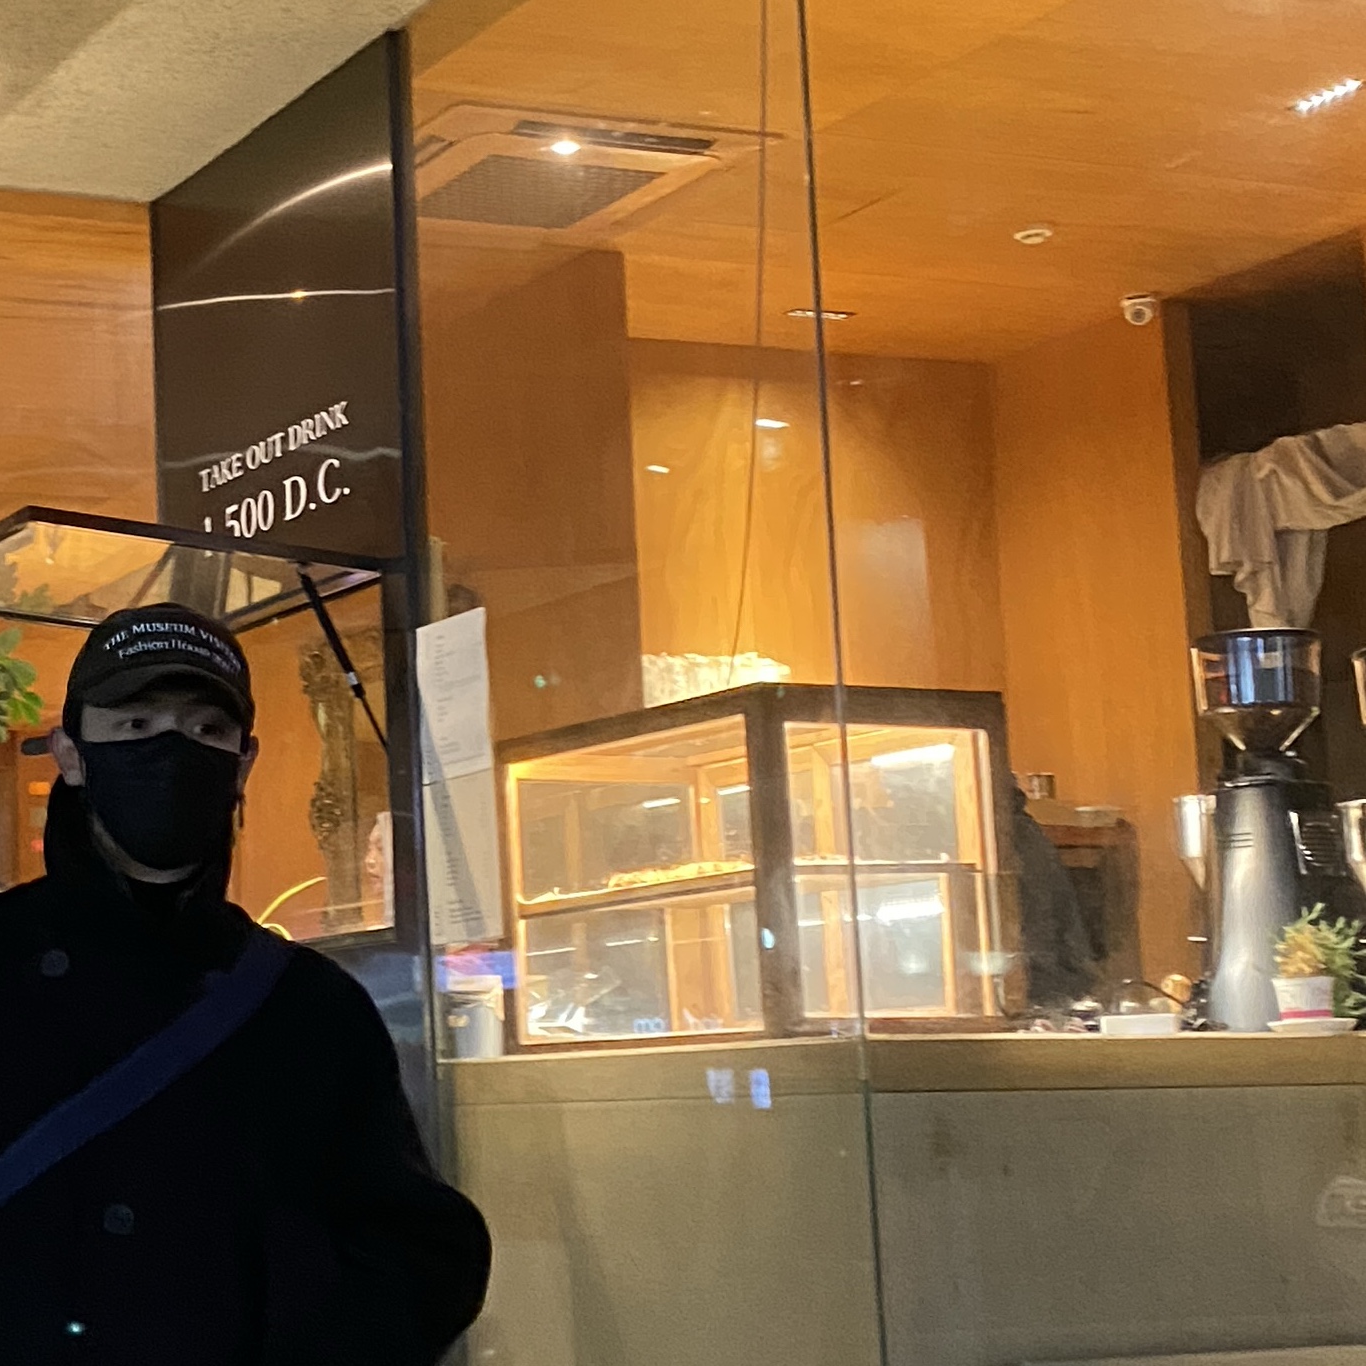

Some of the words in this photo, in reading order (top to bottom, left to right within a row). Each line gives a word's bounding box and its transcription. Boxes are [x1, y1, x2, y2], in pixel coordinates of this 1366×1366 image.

[199, 452, 244, 492] TAKE
[246, 432, 285, 470] OUT
[288, 401, 349, 450] DRINK
[283, 459, 350, 521] D.C.
[103, 630, 129, 650] THE
[132, 622, 196, 636] MUSEUM
[118, 639, 169, 660] Fashion
